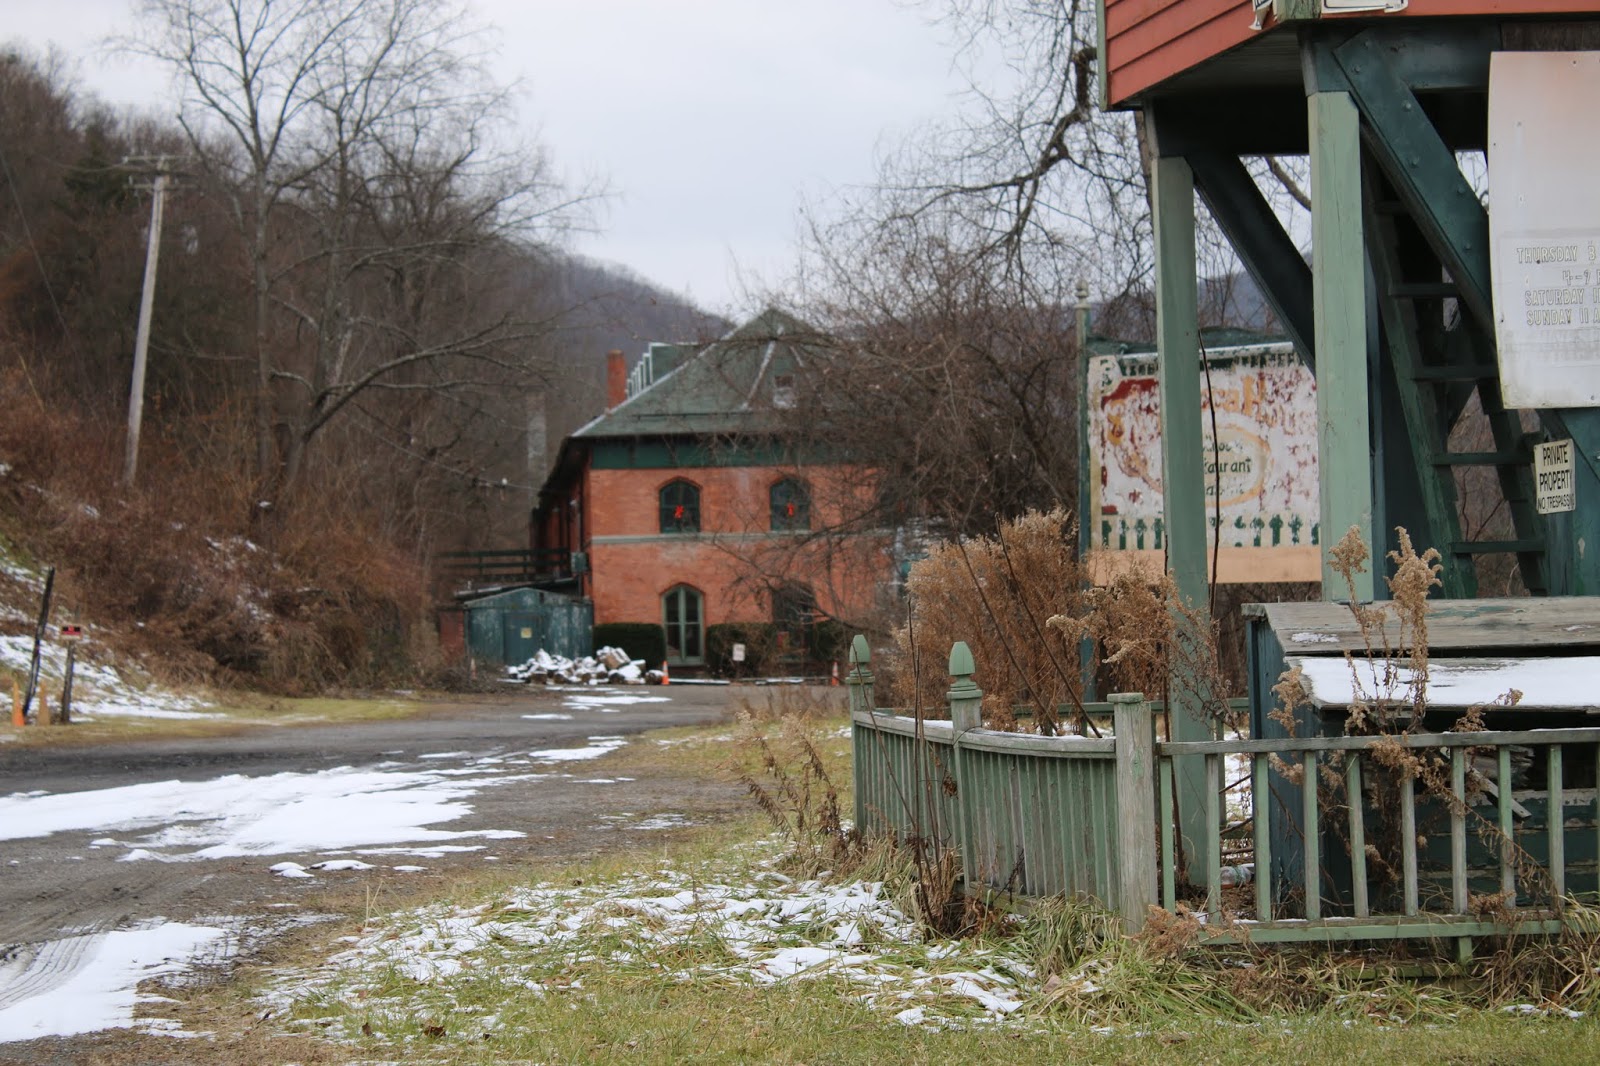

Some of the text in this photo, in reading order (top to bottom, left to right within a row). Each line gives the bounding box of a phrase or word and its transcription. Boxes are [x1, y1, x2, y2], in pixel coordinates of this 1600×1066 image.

[1517, 246, 1577, 264] THURSDAY
[1562, 269, 1591, 286] 4-9
[1524, 288, 1584, 306] SATURDAY
[1526, 308, 1572, 326] SUNDAY
[1542, 443, 1568, 466] PRIVATE
[1538, 497, 1546, 510] NO
